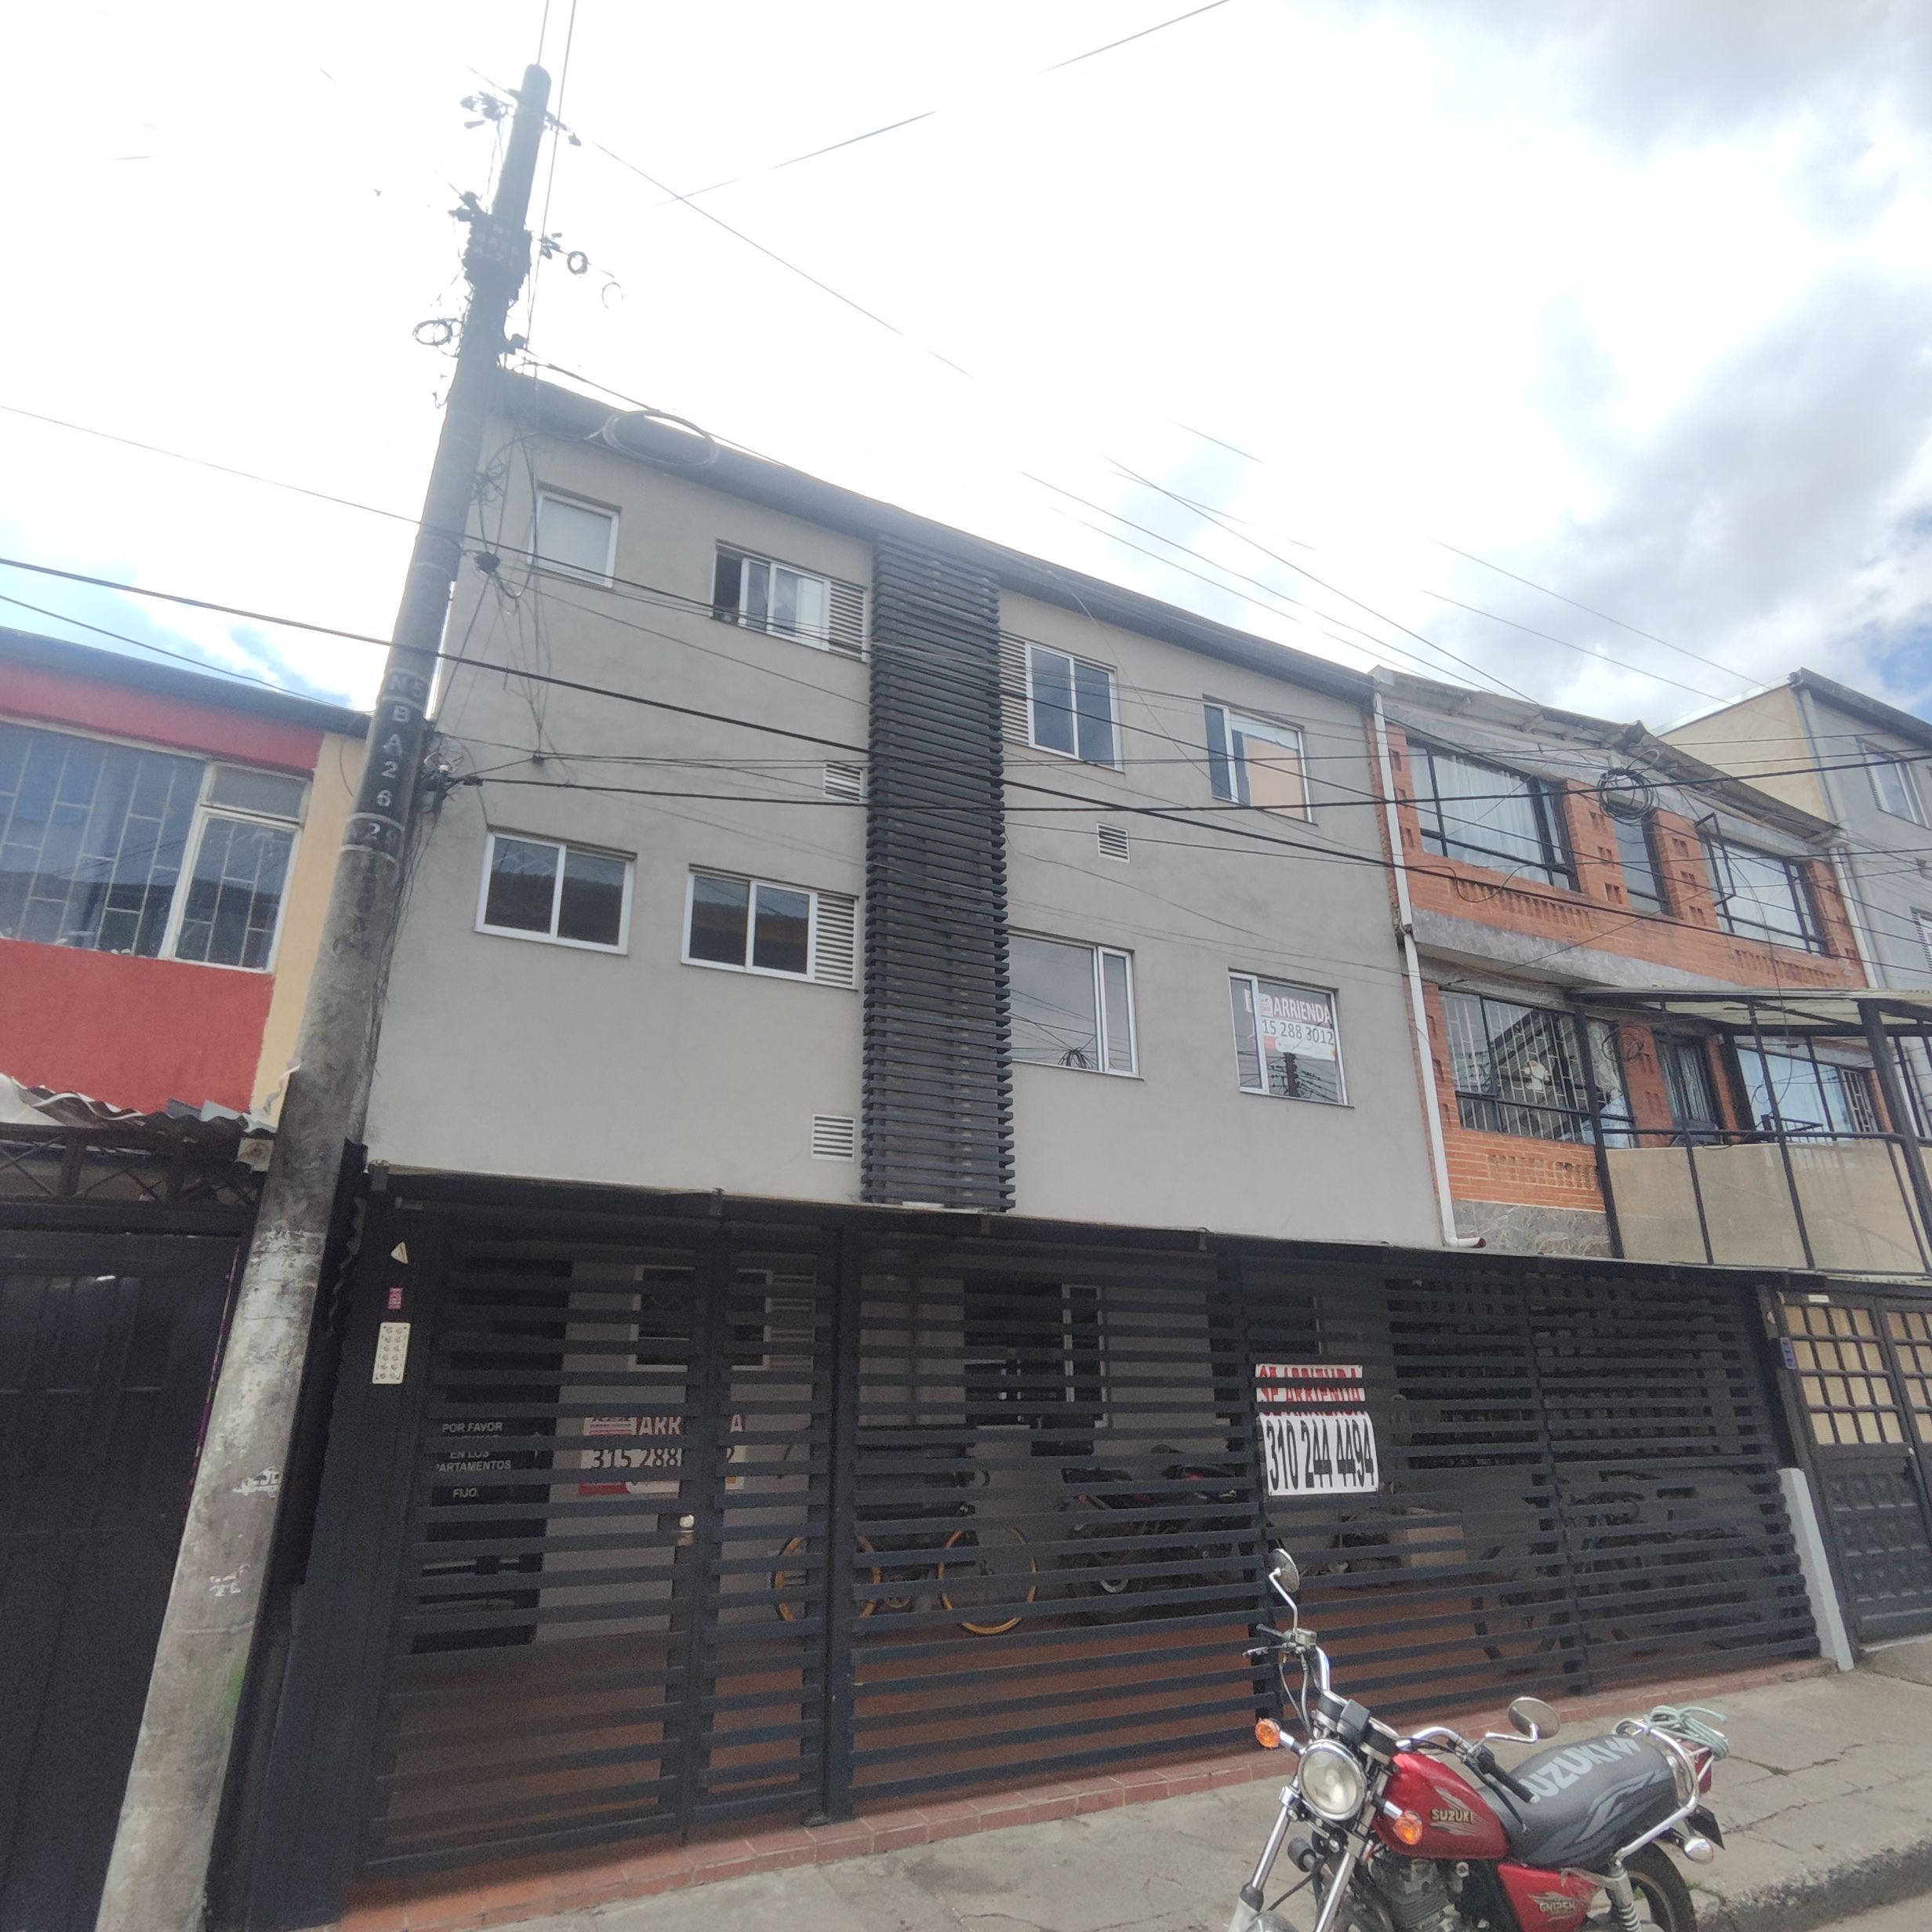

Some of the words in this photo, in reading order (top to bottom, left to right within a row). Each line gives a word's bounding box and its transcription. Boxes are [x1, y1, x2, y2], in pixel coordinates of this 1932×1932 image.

[1273, 997, 1332, 1024] ARRIENDA
[1280, 1022, 1302, 1040] 288
[1306, 1027, 1335, 1046] 3012
[1283, 1366, 1366, 1417] ARRIENDA
[442, 1423, 464, 1433] POR
[467, 1422, 503, 1432] FAVOR
[1266, 1418, 1298, 1491] 310
[1301, 1418, 1333, 1489] 244
[1335, 1418, 1375, 1488] 4494
[453, 1487, 478, 1498] FIJO
[1431, 1808, 1474, 1824] SUZUKI
